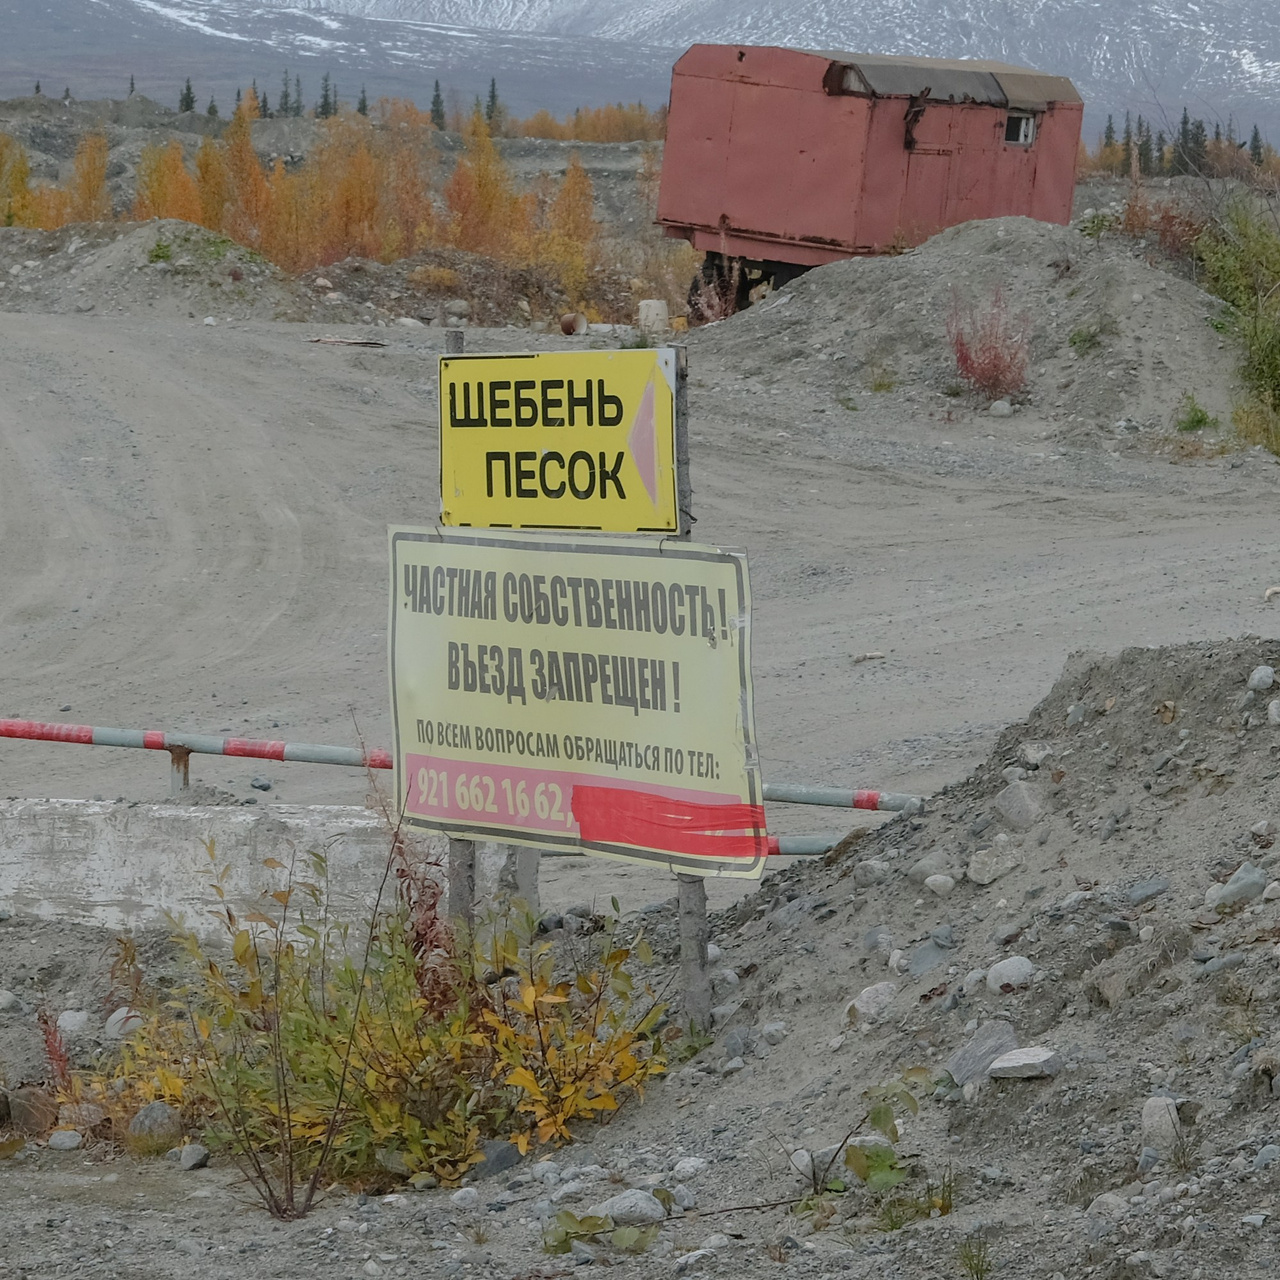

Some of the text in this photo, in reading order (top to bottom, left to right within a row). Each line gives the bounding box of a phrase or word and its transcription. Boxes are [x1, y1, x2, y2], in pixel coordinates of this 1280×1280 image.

[449, 379, 624, 428] ЩЕБЕНЬ
[486, 451, 626, 500] ПЕСОК
[403, 564, 497, 621] ЧАСТНАЯ
[448, 641, 527, 706] ВЪЕЗД
[416, 719, 721, 780] ПО ВСЕМ ВОПРОСАМ ОБРАЩАТЬСЯ ПО ТЕЛ:
[417, 767, 448, 808] 921
[455, 773, 499, 814] 662
[501, 778, 530, 818] 16
